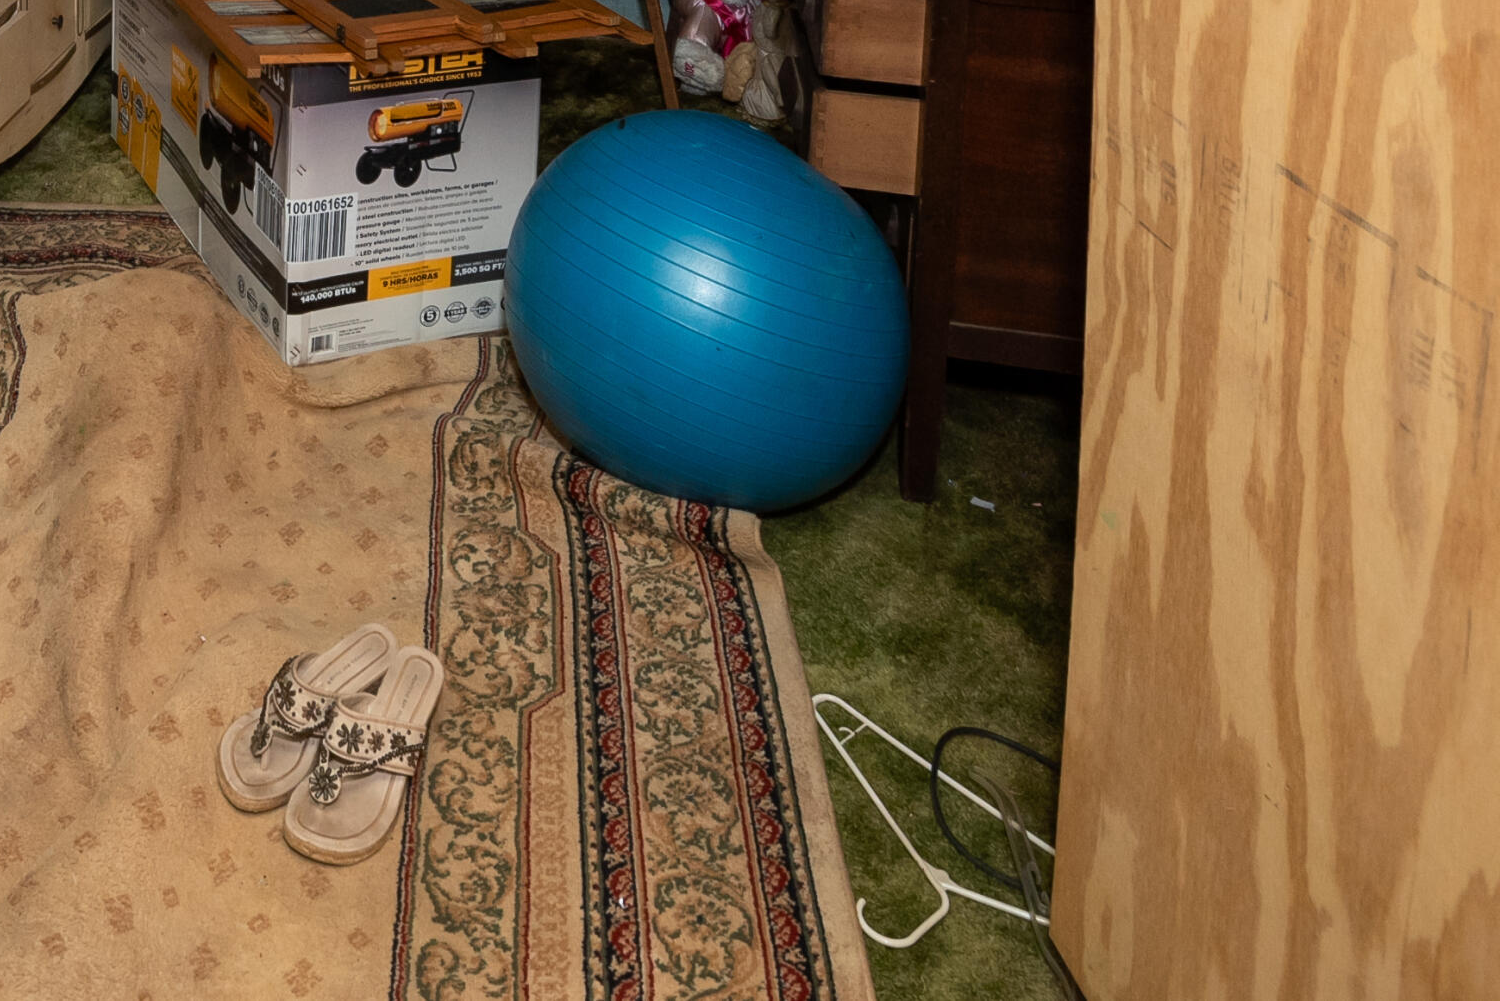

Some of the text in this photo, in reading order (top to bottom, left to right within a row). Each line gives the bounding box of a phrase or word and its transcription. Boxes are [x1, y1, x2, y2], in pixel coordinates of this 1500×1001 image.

[363, 79, 418, 92] PROFESSIONAL'S
[419, 75, 444, 85] CHOICE
[445, 73, 466, 82] SINCE
[287, 196, 354, 215] 1001061652
[359, 227, 401, 240] Safety System
[454, 266, 478, 277] 3,500
[479, 265, 491, 274] SQ
[382, 279, 388, 288] 9
[389, 272, 439, 286] HRS/HORAS
[301, 290, 333, 304] 140,000
[334, 287, 357, 298] BTUs
[427, 309, 435, 319] 5
